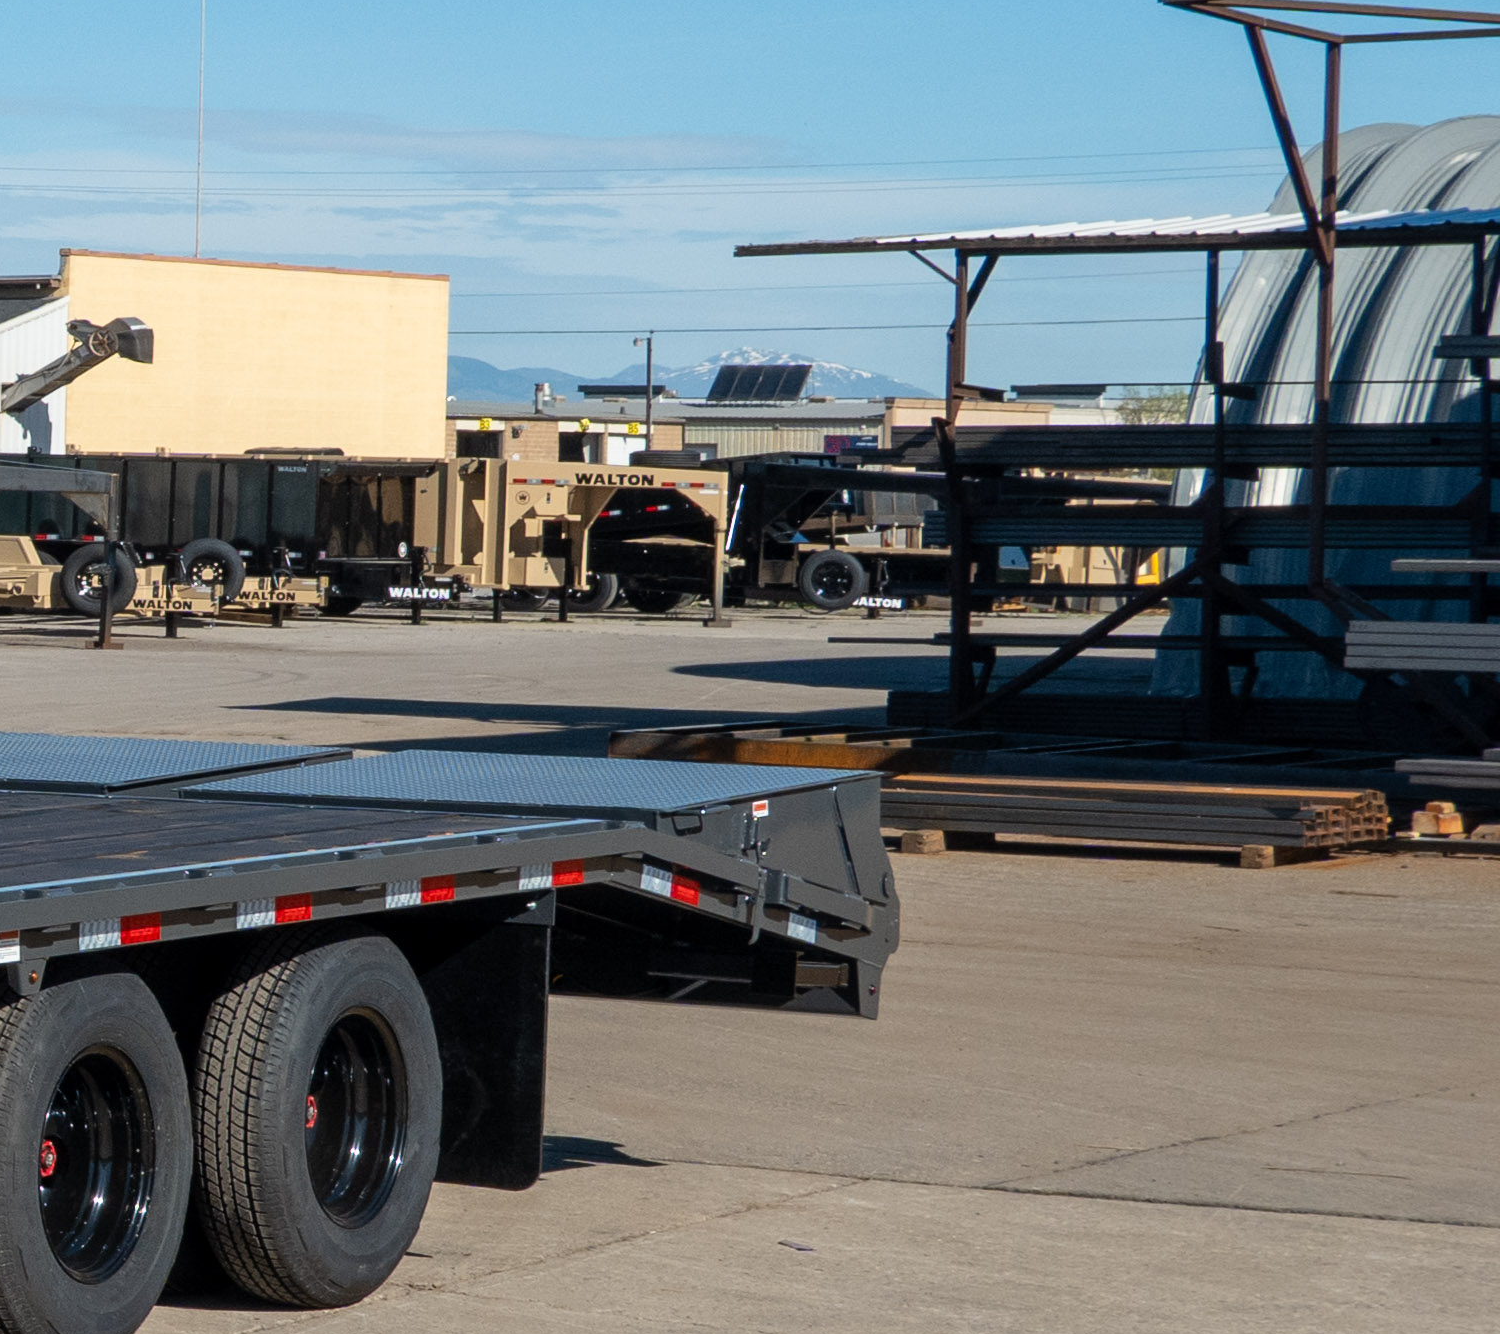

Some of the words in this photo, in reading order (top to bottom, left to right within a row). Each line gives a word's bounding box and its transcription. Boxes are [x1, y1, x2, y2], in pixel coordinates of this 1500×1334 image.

[575, 473, 654, 486] WALTON
[239, 591, 296, 601] WALTON
[389, 587, 451, 599] WALTON
[133, 599, 193, 610] WALTON
[852, 597, 903, 609] ALTON
